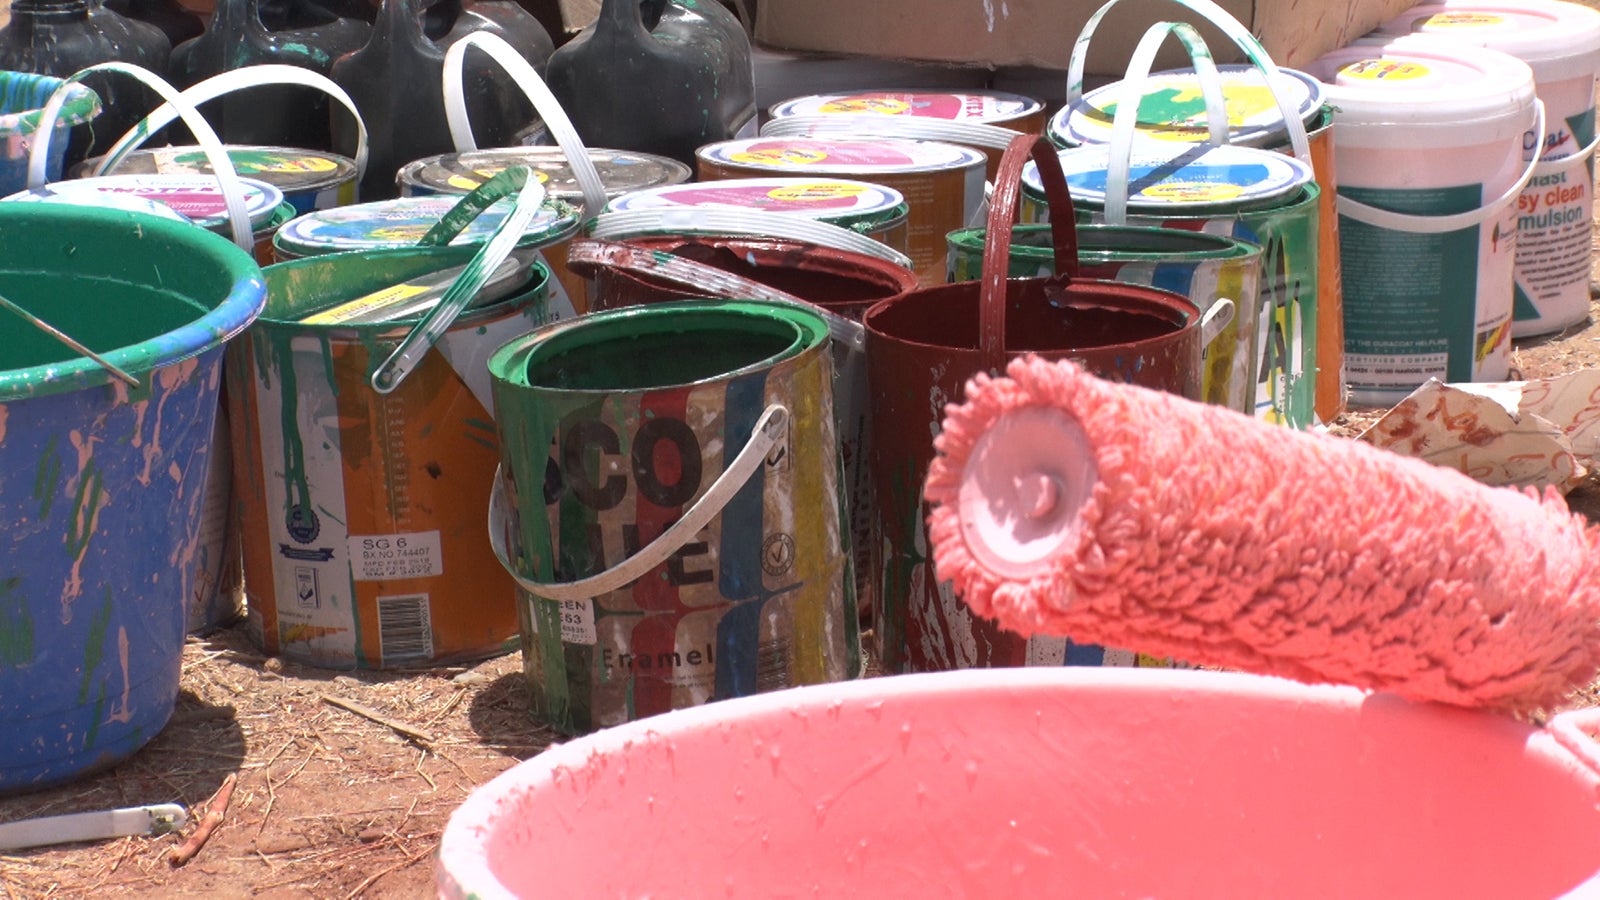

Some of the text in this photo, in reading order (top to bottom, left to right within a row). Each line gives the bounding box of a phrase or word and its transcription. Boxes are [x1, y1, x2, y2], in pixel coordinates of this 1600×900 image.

[1545, 184, 1584, 206] clean
[1517, 206, 1582, 230] mulsion
[363, 537, 408, 550] SG 6
[602, 643, 713, 669] Enamel
